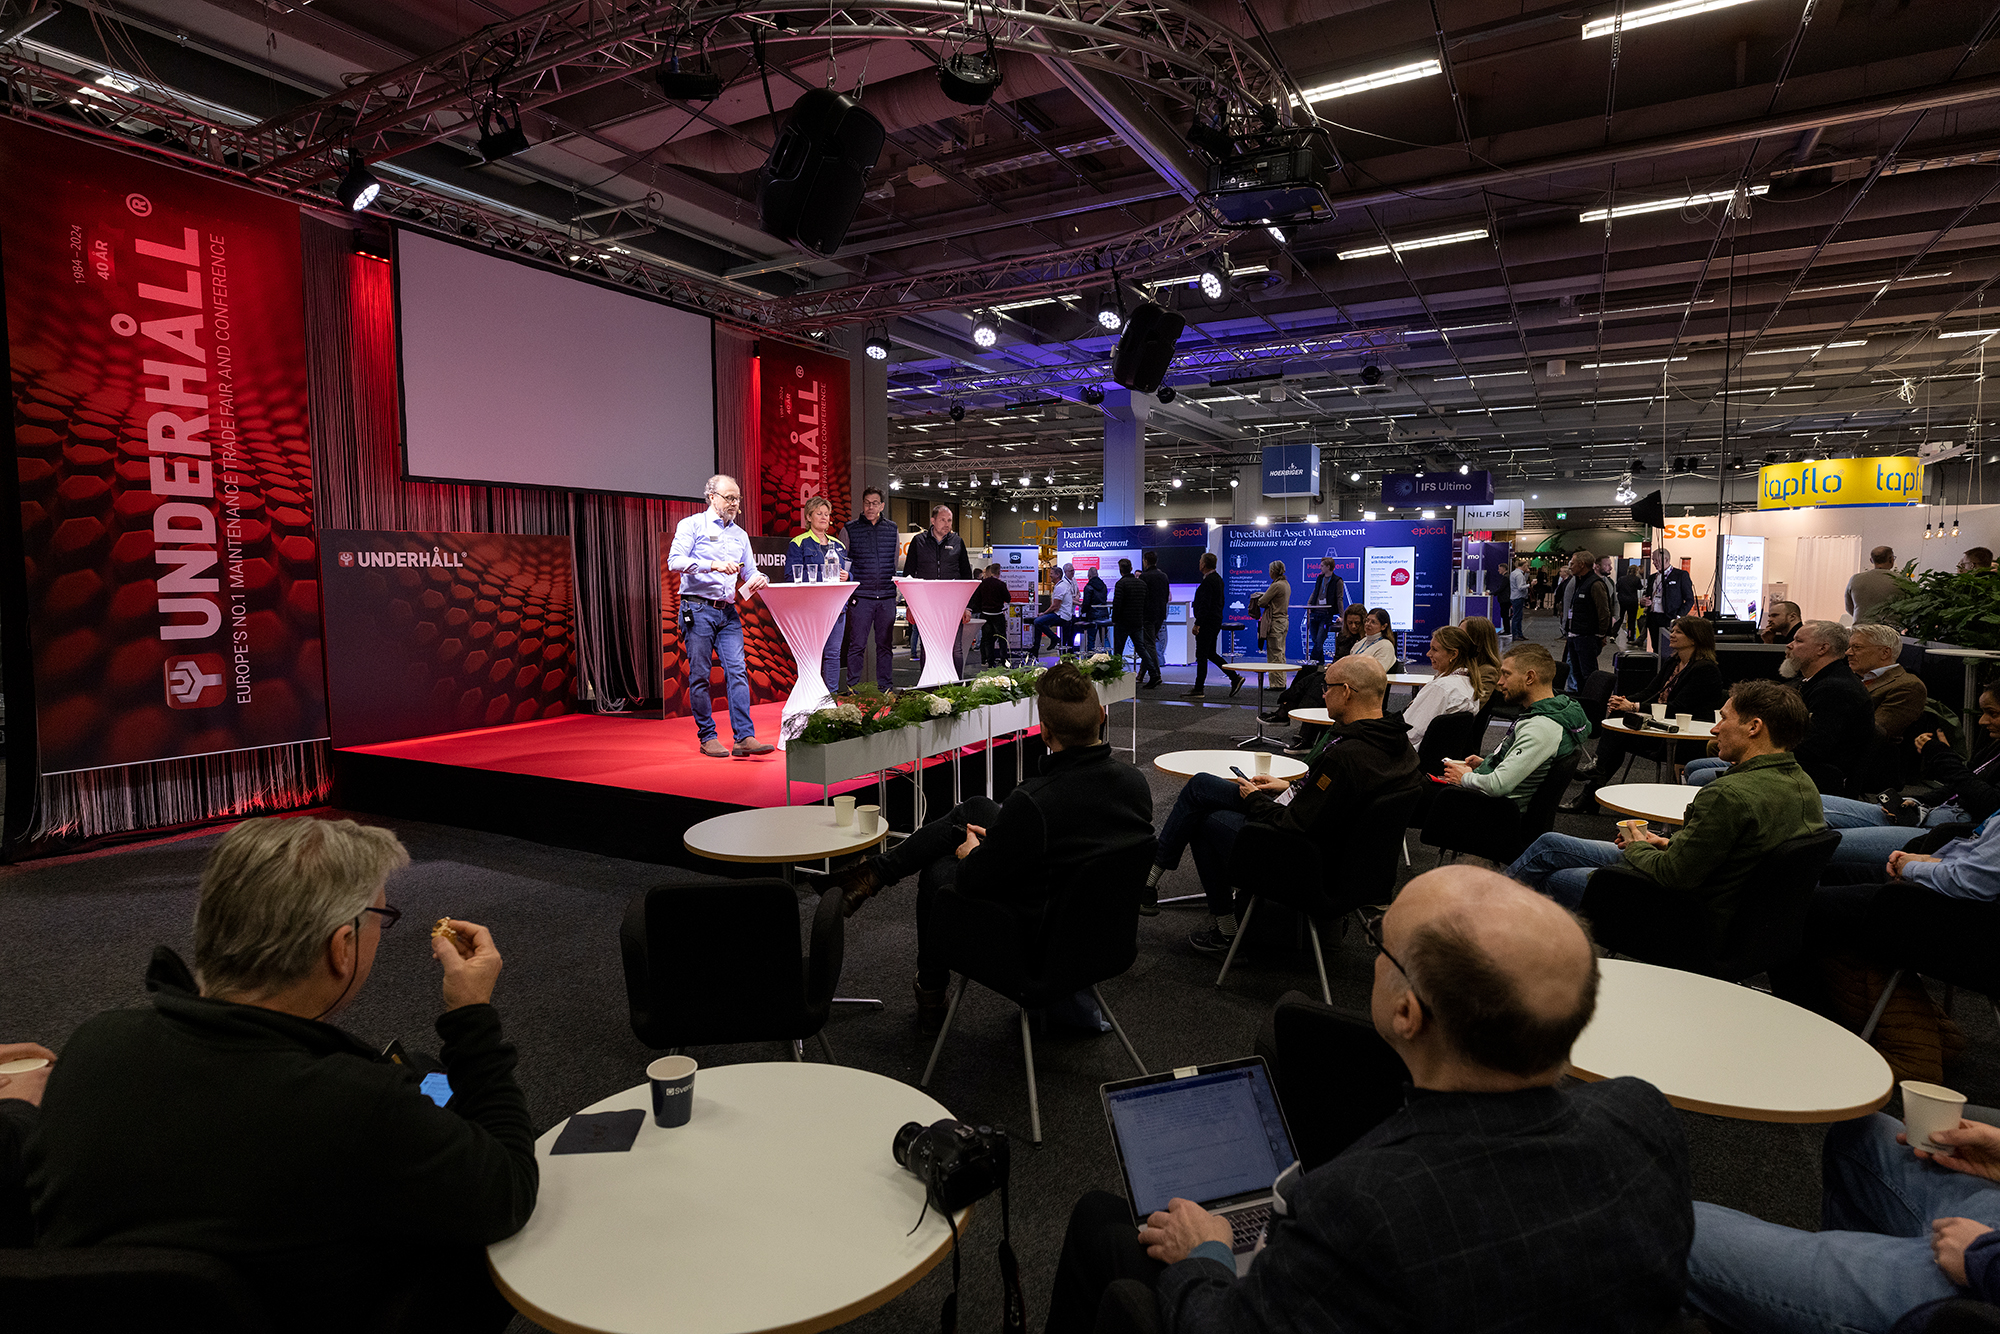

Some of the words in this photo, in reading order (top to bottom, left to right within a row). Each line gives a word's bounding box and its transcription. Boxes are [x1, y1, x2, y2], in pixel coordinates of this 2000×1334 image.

[92, 240, 108, 261] ÅR
[97, 262, 110, 280] 40
[209, 233, 230, 341] CONFERENCE
[216, 345, 232, 379] AND
[218, 383, 234, 416] FAIR
[819, 382, 828, 442] CONFERENCE
[220, 419, 239, 471] TRADE
[1269, 468, 1304, 477] HOERBIGER
[1421, 482, 1437, 491] IFS
[1438, 481, 1472, 491] Ultimo
[1764, 467, 1842, 501] tapflo
[1467, 510, 1510, 518] NILFISK
[223, 474, 245, 588] MAINTENANCE
[1063, 530, 1102, 539] Datadrivet
[1172, 527, 1203, 539] epical
[1229, 529, 1266, 539] Utveckla
[1267, 529, 1283, 538] ditt
[1283, 528, 1306, 537] Asset
[1308, 528, 1366, 538] Management
[1411, 525, 1447, 537] epical
[1663, 524, 1707, 539] SSG
[1062, 540, 1082, 549] Asset
[1082, 539, 1129, 549] Management
[1229, 539, 1278, 548] tillsammans
[1280, 538, 1298, 547] med
[231, 593, 248, 628] NO.1
